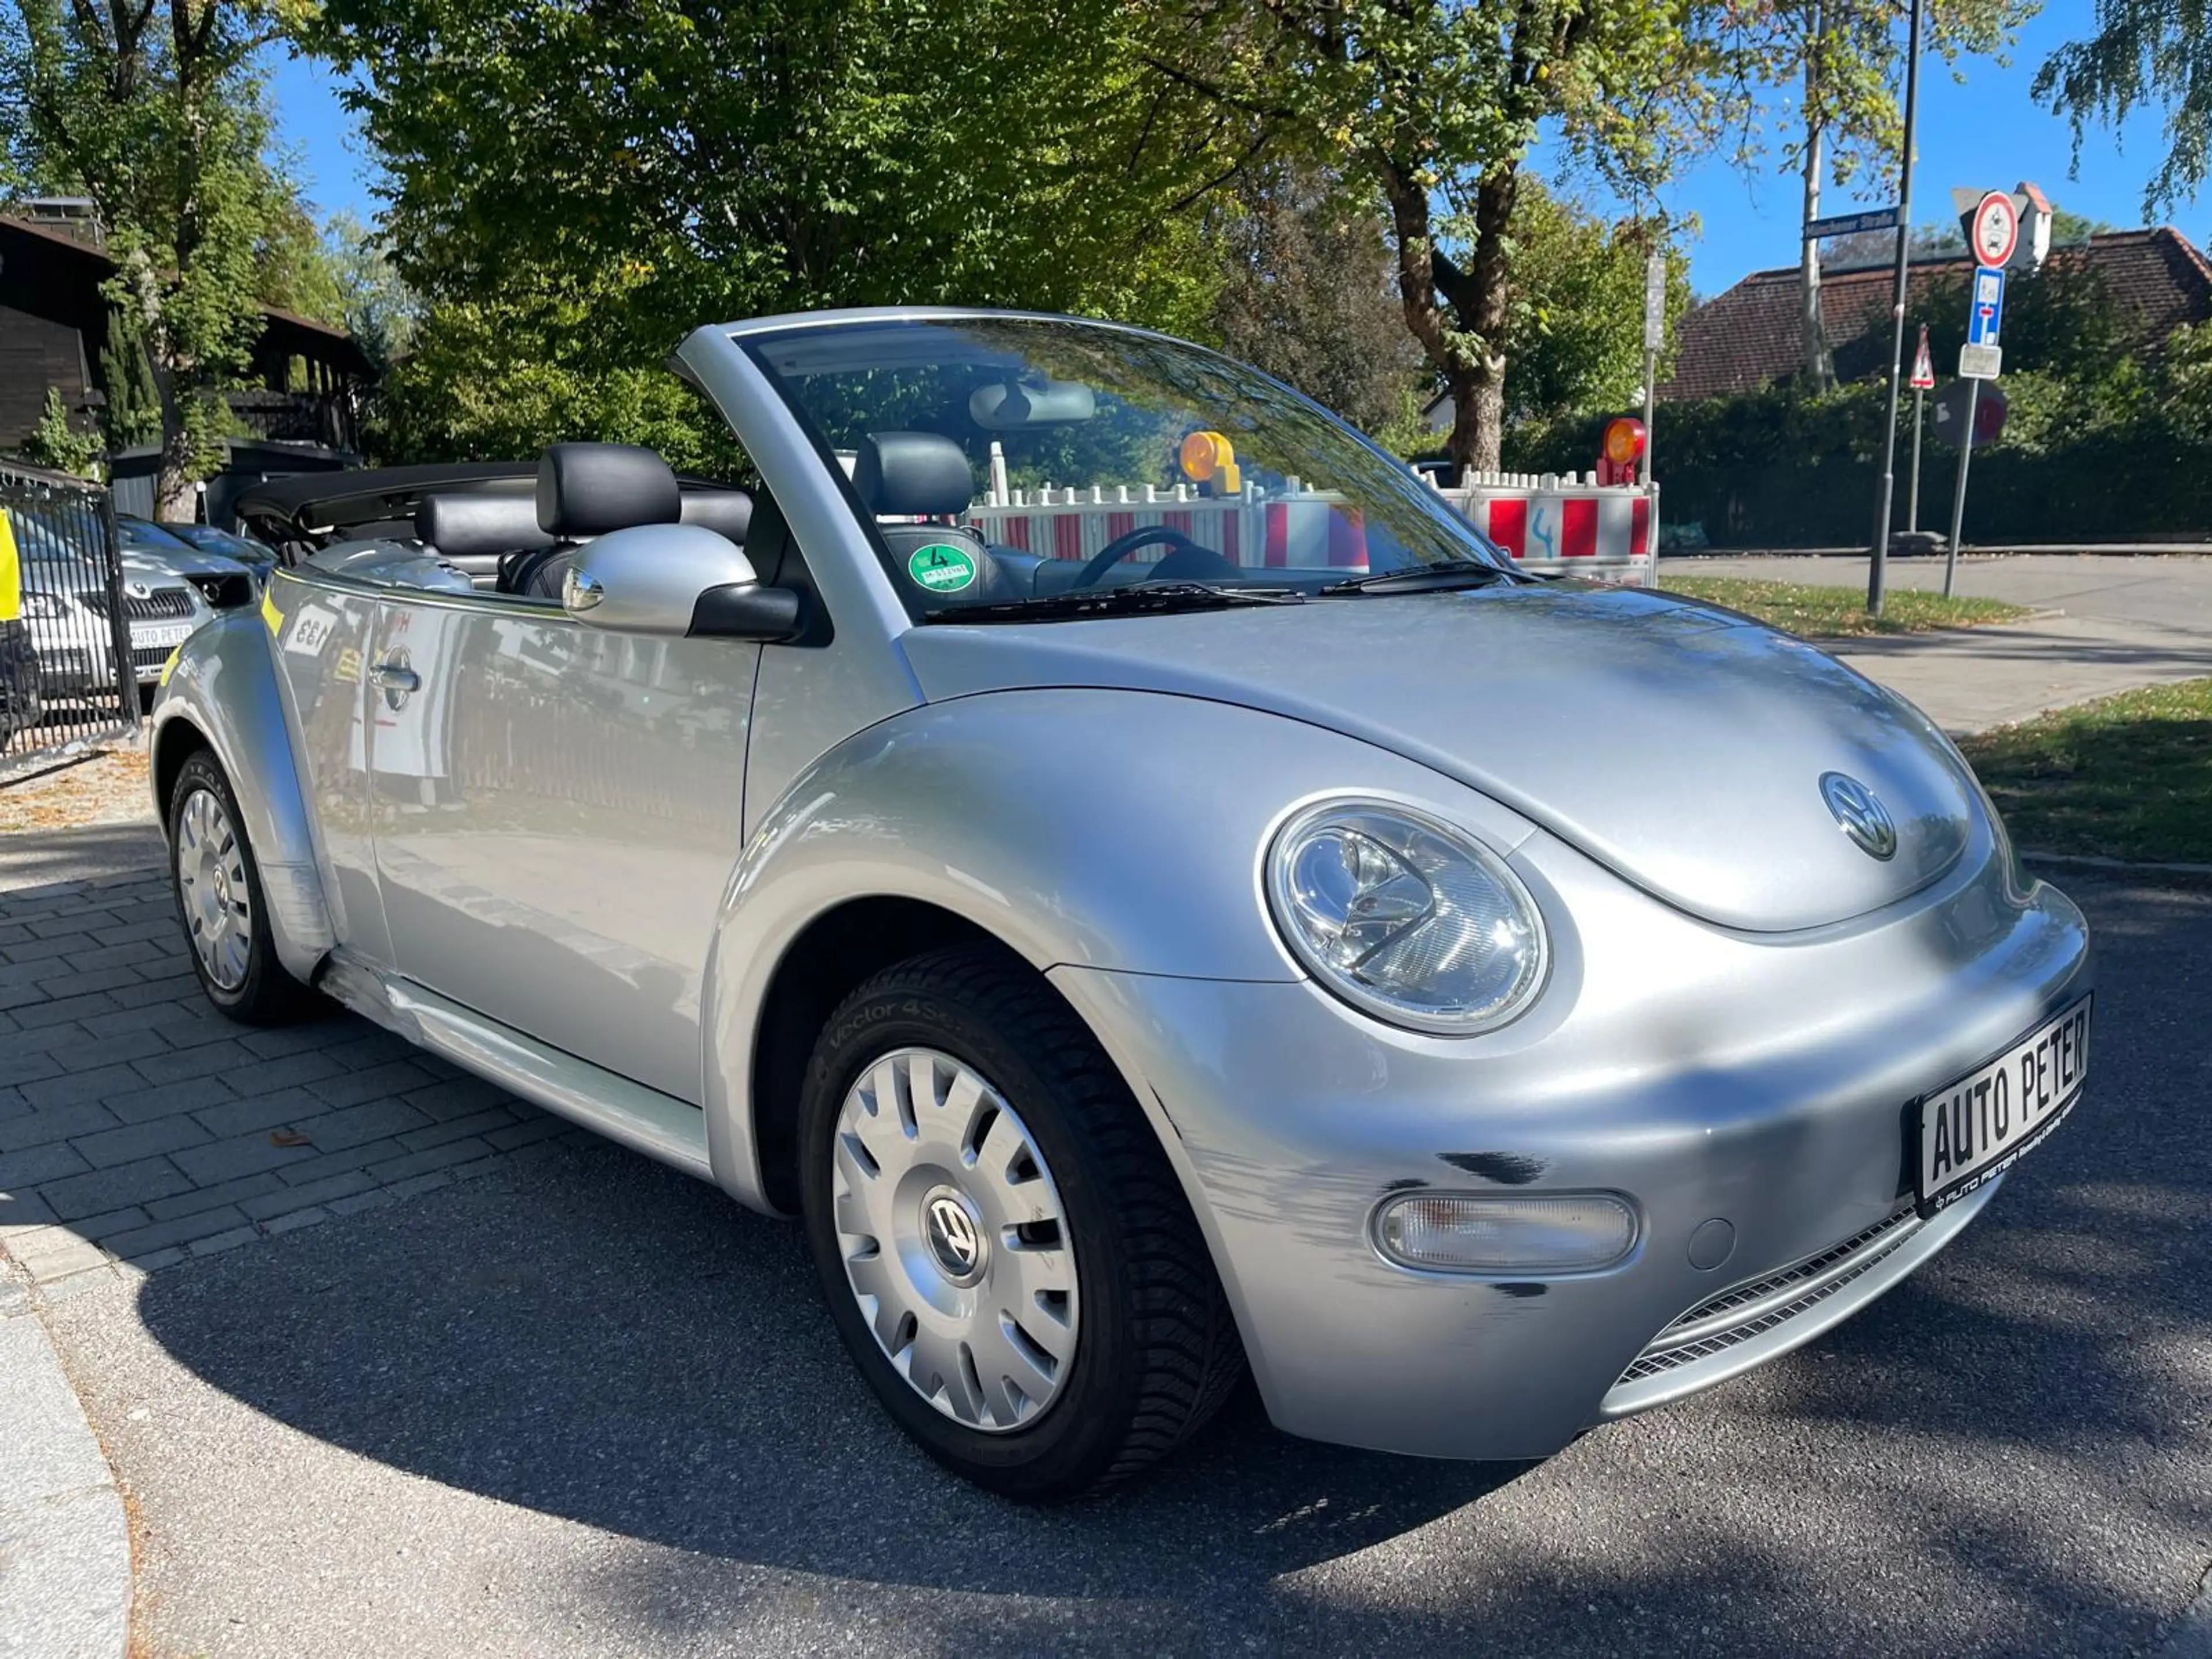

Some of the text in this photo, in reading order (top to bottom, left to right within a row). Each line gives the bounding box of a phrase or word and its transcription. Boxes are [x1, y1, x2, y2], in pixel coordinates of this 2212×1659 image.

[1860, 212, 1894, 229] Straße
[930, 547, 948, 566] 4
[1532, 507, 1553, 559] 4
[1933, 1067, 2008, 1181] AUTO
[2021, 1009, 2085, 1122] PETER
[1945, 1152, 2017, 1205] AUTO PETER
